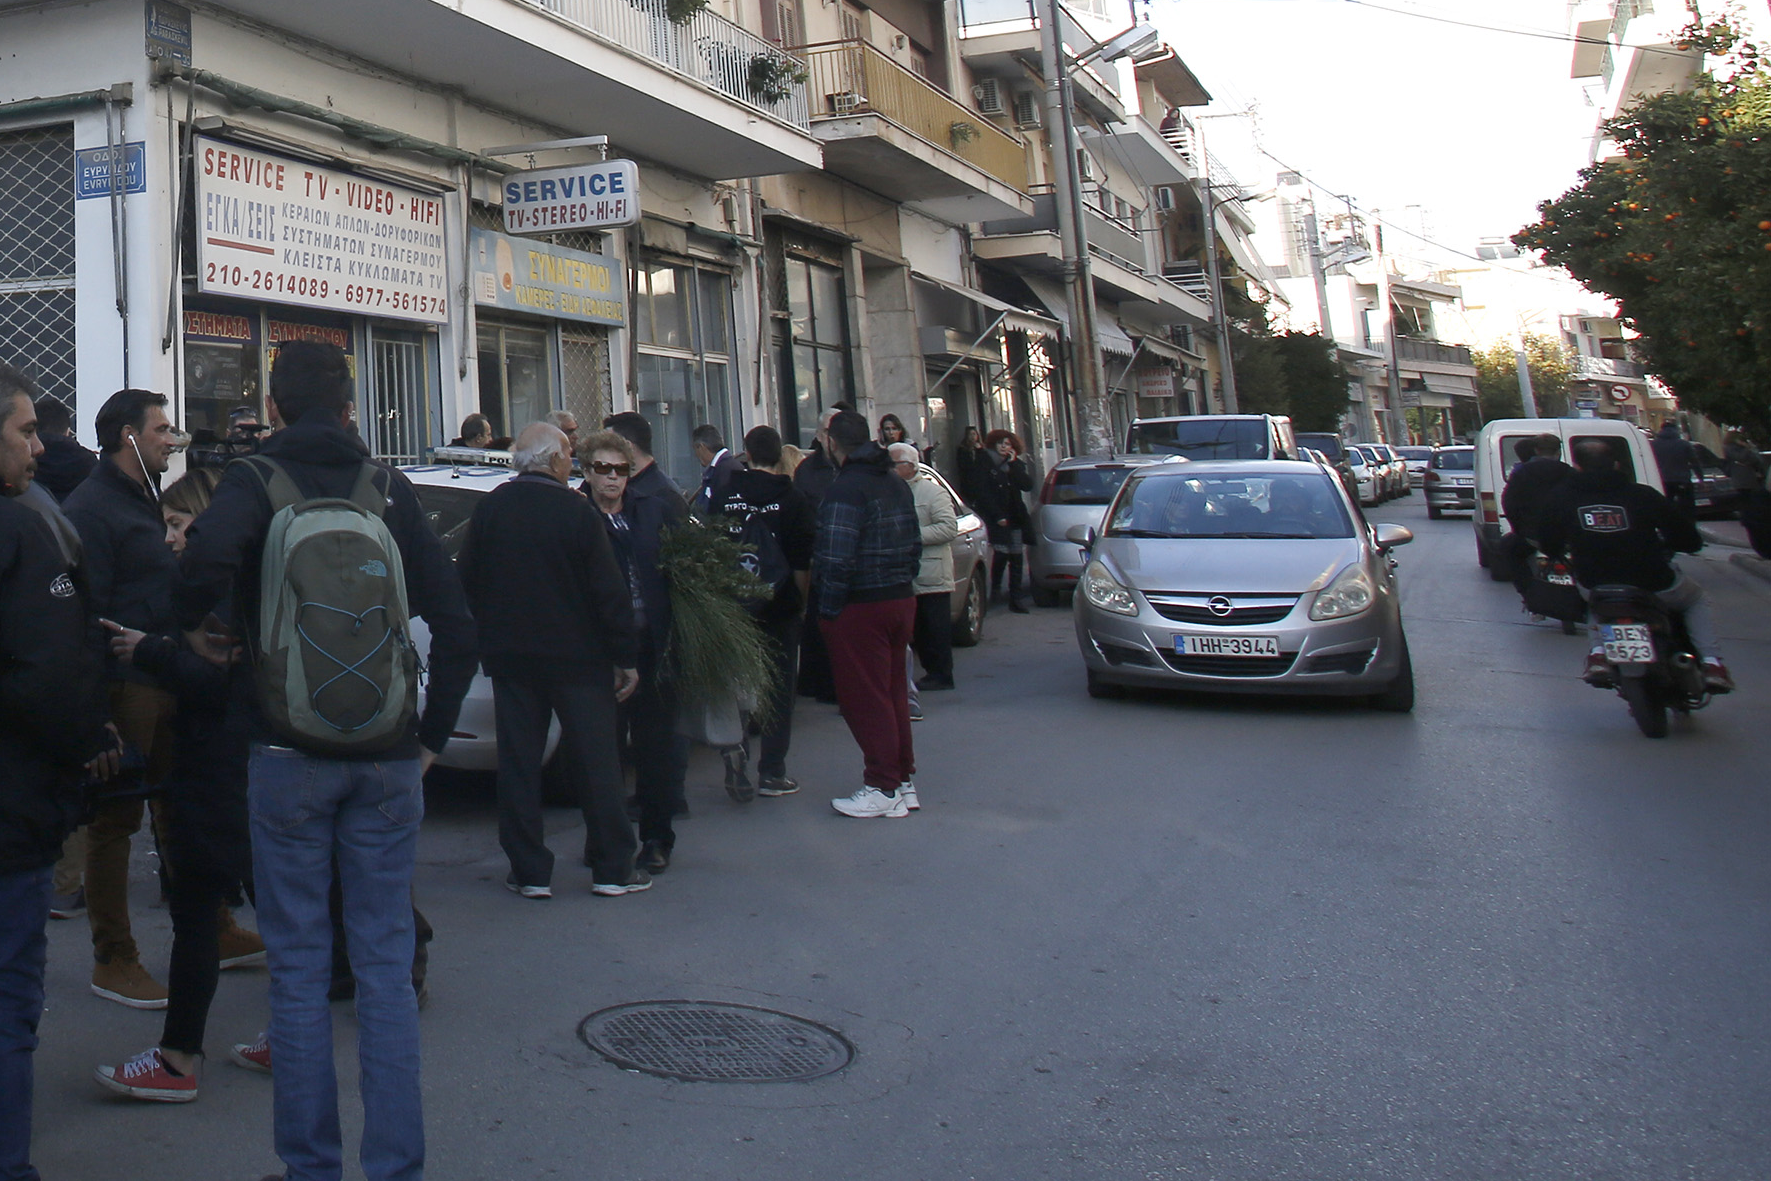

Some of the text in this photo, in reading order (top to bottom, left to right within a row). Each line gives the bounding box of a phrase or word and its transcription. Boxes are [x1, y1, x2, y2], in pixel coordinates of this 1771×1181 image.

[93, 150, 124, 162] ΟΔΟ
[204, 148, 285, 191] SERVICE
[304, 172, 329, 200] TV
[347, 181, 394, 215] VIDEO
[411, 197, 440, 226] HIFI
[506, 172, 625, 204] SERVICE
[207, 192, 275, 242] ΕΓΚΑ/ΣΕΙΣ
[282, 202, 330, 226] ΚΕΡΑΙΩΝ
[283, 226, 441, 268] ΣΥΣΤΗΜΑΤΩΝ ΣΥΝΑΓΕΡΜΟΥ
[207, 262, 328, 298] 210-2614089
[346, 284, 445, 315] 6977-561574
[284, 248, 442, 289] ΚΛΕΙΣΤΑ ΚΥΚΛΩΜΑΤΑ TV
[528, 250, 612, 293] ΣΥΝΑΓΕΡΜΟΙ
[515, 284, 555, 310] ΚΑΜΕΡΕΣ
